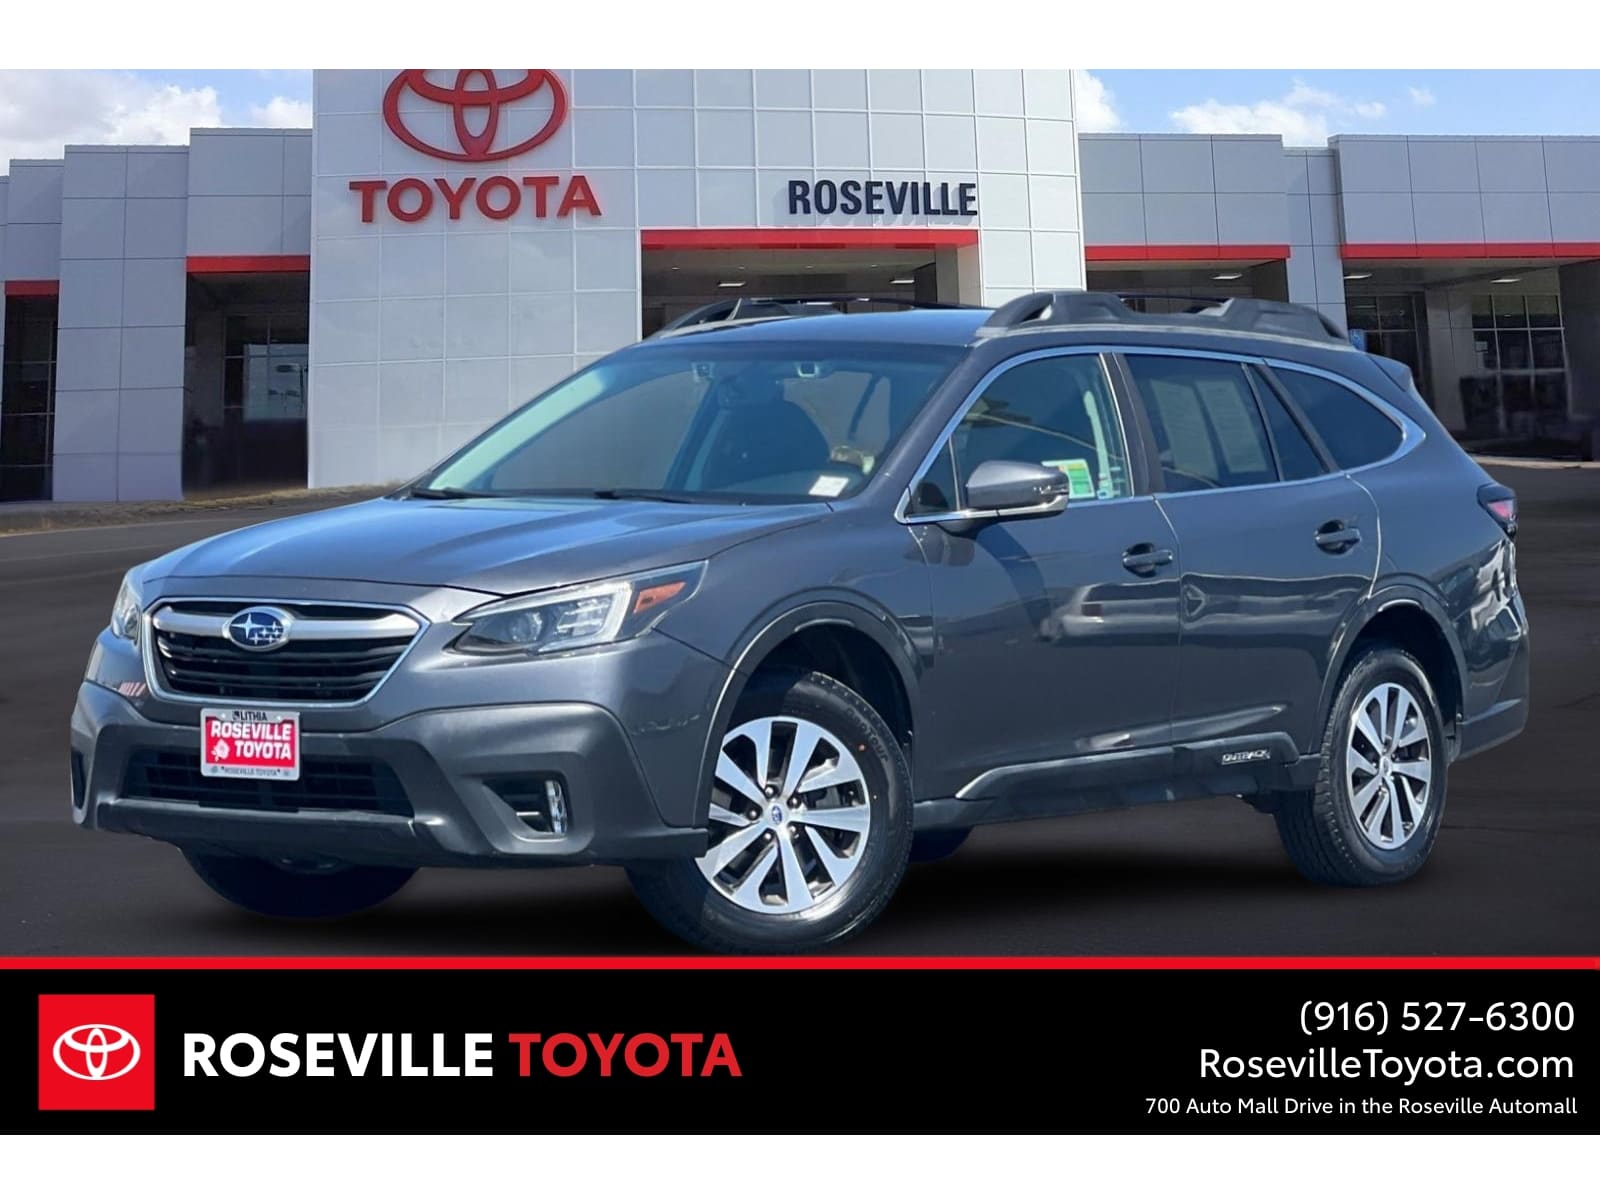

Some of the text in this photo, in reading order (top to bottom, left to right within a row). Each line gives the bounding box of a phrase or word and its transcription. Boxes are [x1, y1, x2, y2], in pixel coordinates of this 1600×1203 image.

[349, 175, 602, 223] TOYOTA
[788, 180, 978, 216] ROSEVILLE
[240, 711, 268, 721] LITHIA
[210, 720, 293, 741] ROSEVILLE
[234, 740, 292, 760] TOYOTA
[1222, 749, 1271, 761] OUTBACK
